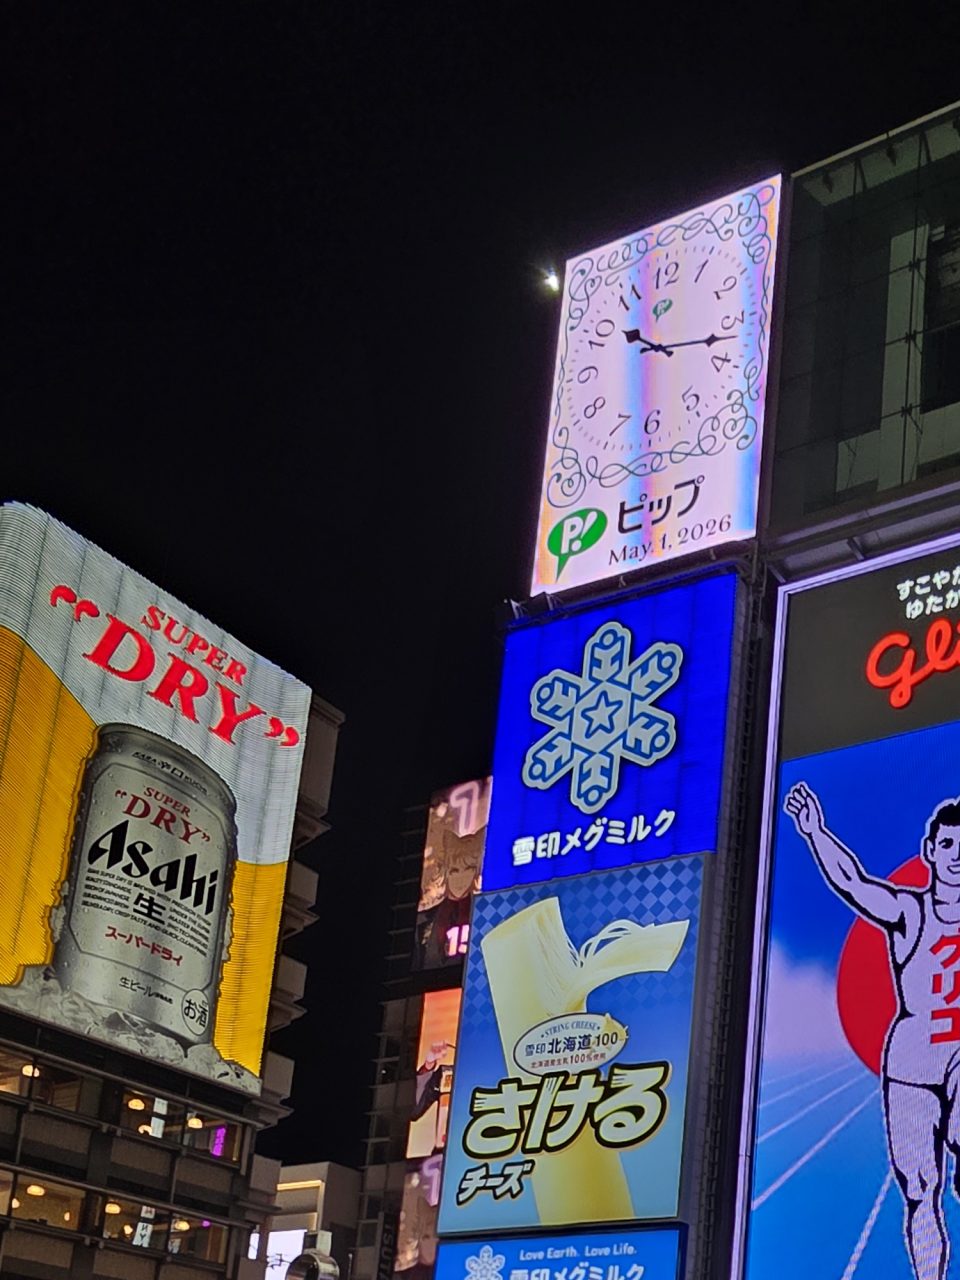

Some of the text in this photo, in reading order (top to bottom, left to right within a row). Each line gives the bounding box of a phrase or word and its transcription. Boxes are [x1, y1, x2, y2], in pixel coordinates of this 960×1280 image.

[652, 261, 679, 288] 12
[693, 259, 709, 283] 1
[618, 285, 642, 311] 11
[713, 276, 737, 301] 2
[721, 310, 745, 330] 3
[589, 319, 615, 350] 10
[577, 366, 598, 384] 9
[711, 351, 731, 373] 4
[583, 396, 606, 420] 8
[681, 387, 700, 412] 5
[609, 414, 631, 438] 7
[644, 410, 661, 435] 6
[617, 475, 705, 534] ピップ
[677, 514, 732, 543] 2026
[140, 604, 249, 686] SUPER
[144, 786, 191, 817] SUPER
[512, 809, 675, 867] 雪印メグミルク
[88, 820, 219, 916] Asahi
[133, 892, 166, 925] 生
[105, 925, 183, 966] スーパードライ
[119, 976, 155, 998] 生ビール
[184, 998, 209, 1028] お酒
[462, 1060, 671, 1158] さける
[457, 1160, 535, 1205] チーズ
[519, 1249, 545, 1261] Love
[584, 1245, 611, 1257] Love
